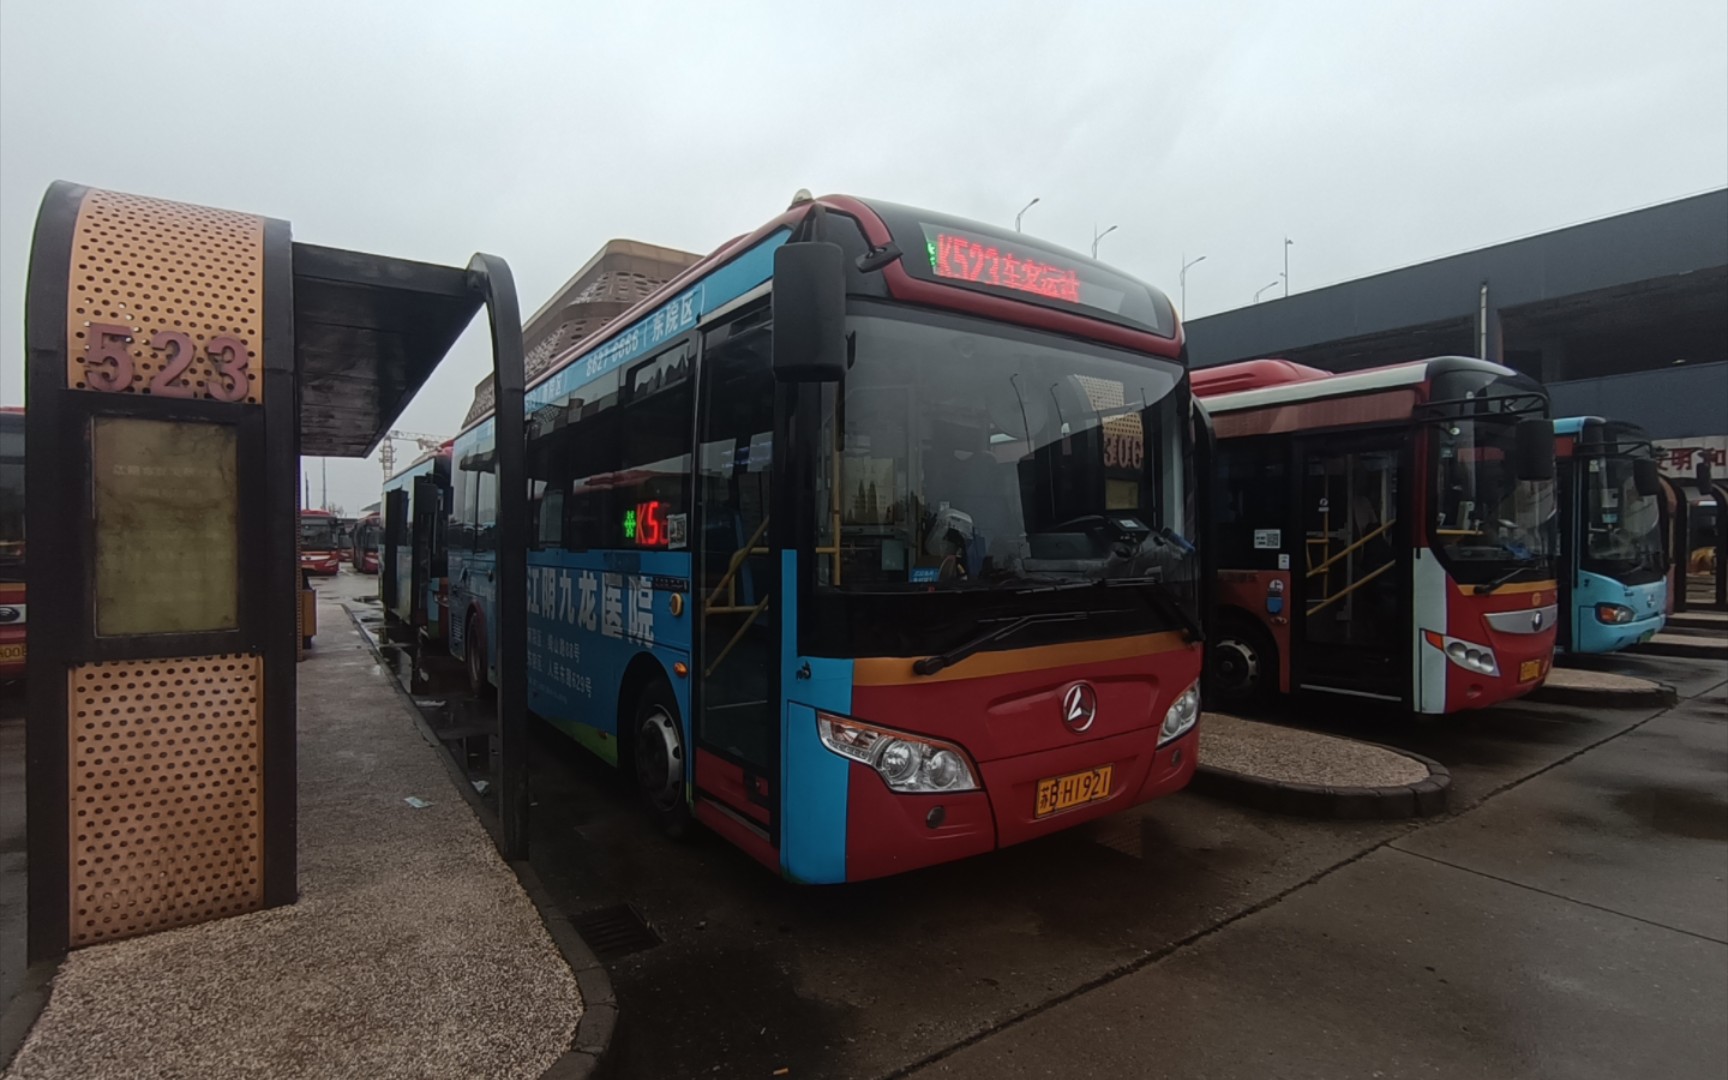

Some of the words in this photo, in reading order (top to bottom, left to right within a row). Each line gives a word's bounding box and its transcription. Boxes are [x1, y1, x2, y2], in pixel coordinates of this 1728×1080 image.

[85, 322, 249, 401] 523
[527, 566, 654, 648] 江阴九龙医院
